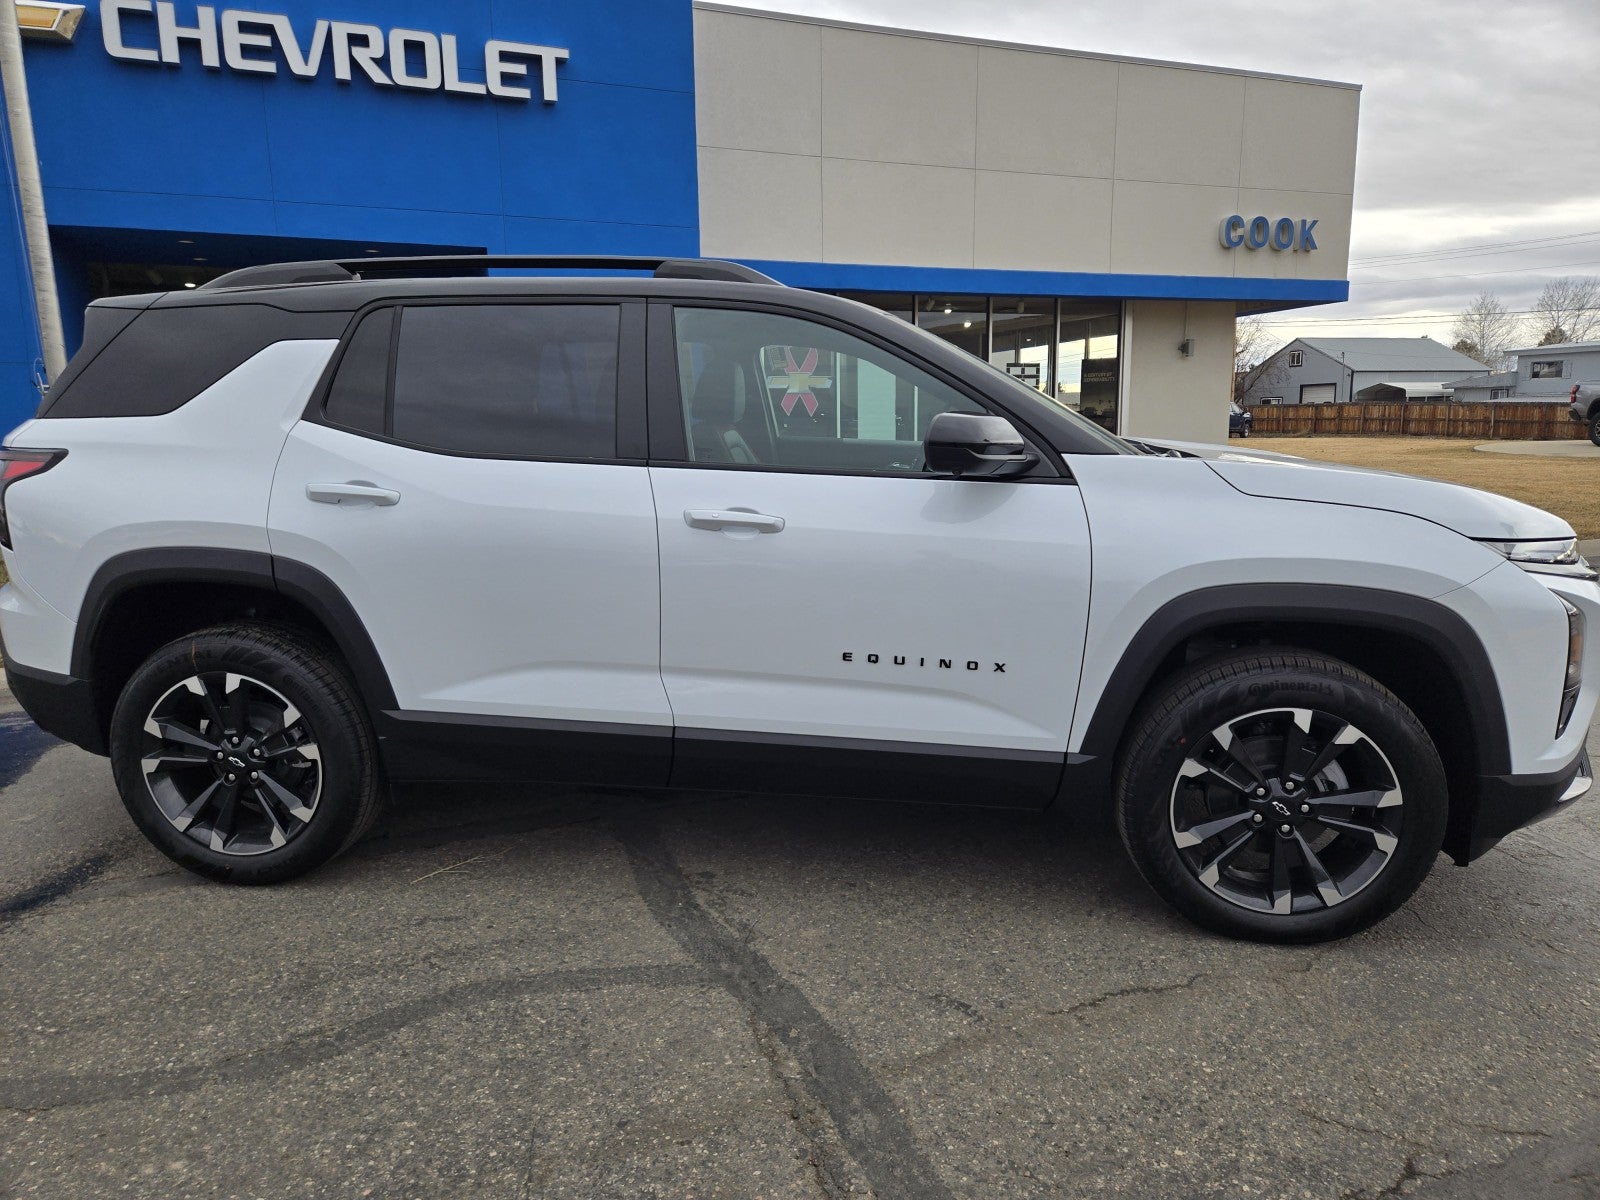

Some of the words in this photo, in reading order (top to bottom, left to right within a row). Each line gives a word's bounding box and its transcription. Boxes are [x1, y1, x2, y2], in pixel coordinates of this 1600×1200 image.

[100, 0, 570, 102] CHEVROLET
[1220, 214, 1319, 251] COOK
[841, 651, 1007, 673] EQUINOX
[1248, 680, 1323, 696] Continental
